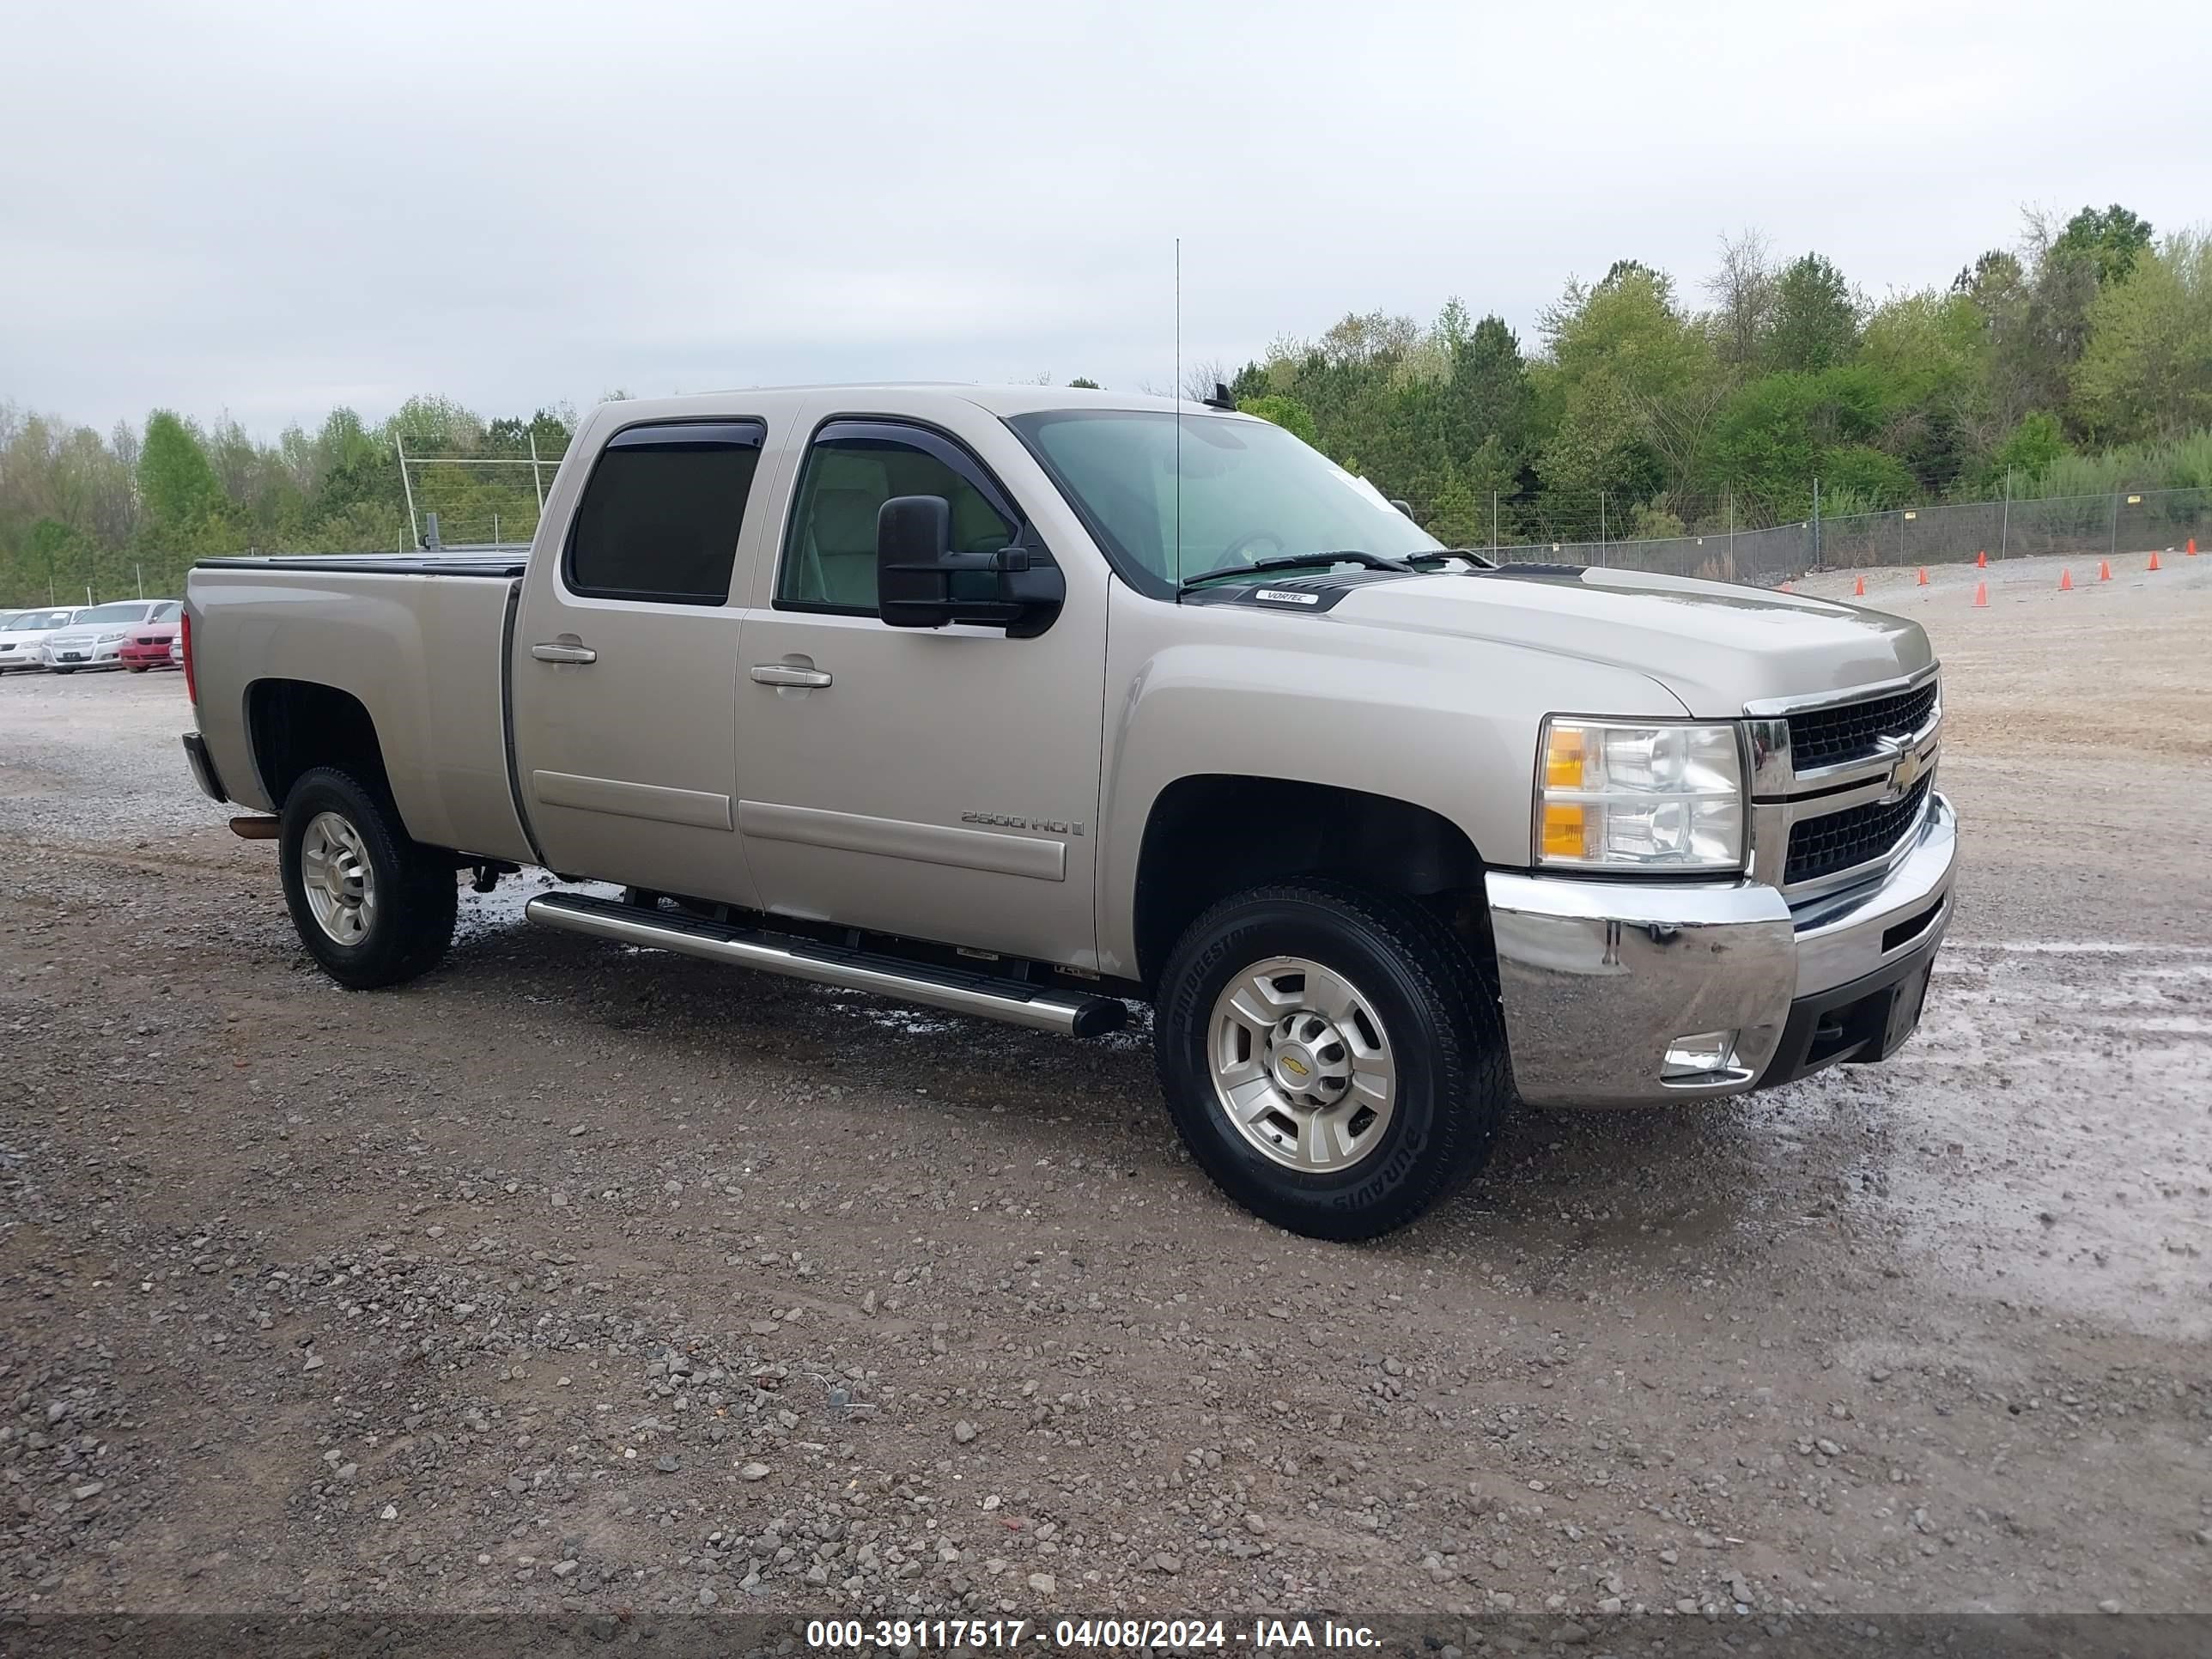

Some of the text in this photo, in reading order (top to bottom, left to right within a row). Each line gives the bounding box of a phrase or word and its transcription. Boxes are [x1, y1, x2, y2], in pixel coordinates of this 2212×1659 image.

[1267, 592, 1308, 602] VORTEC
[961, 810, 1026, 829] 2500
[1031, 817, 1068, 834] HD
[1332, 1126, 1422, 1210] DURAVIS
